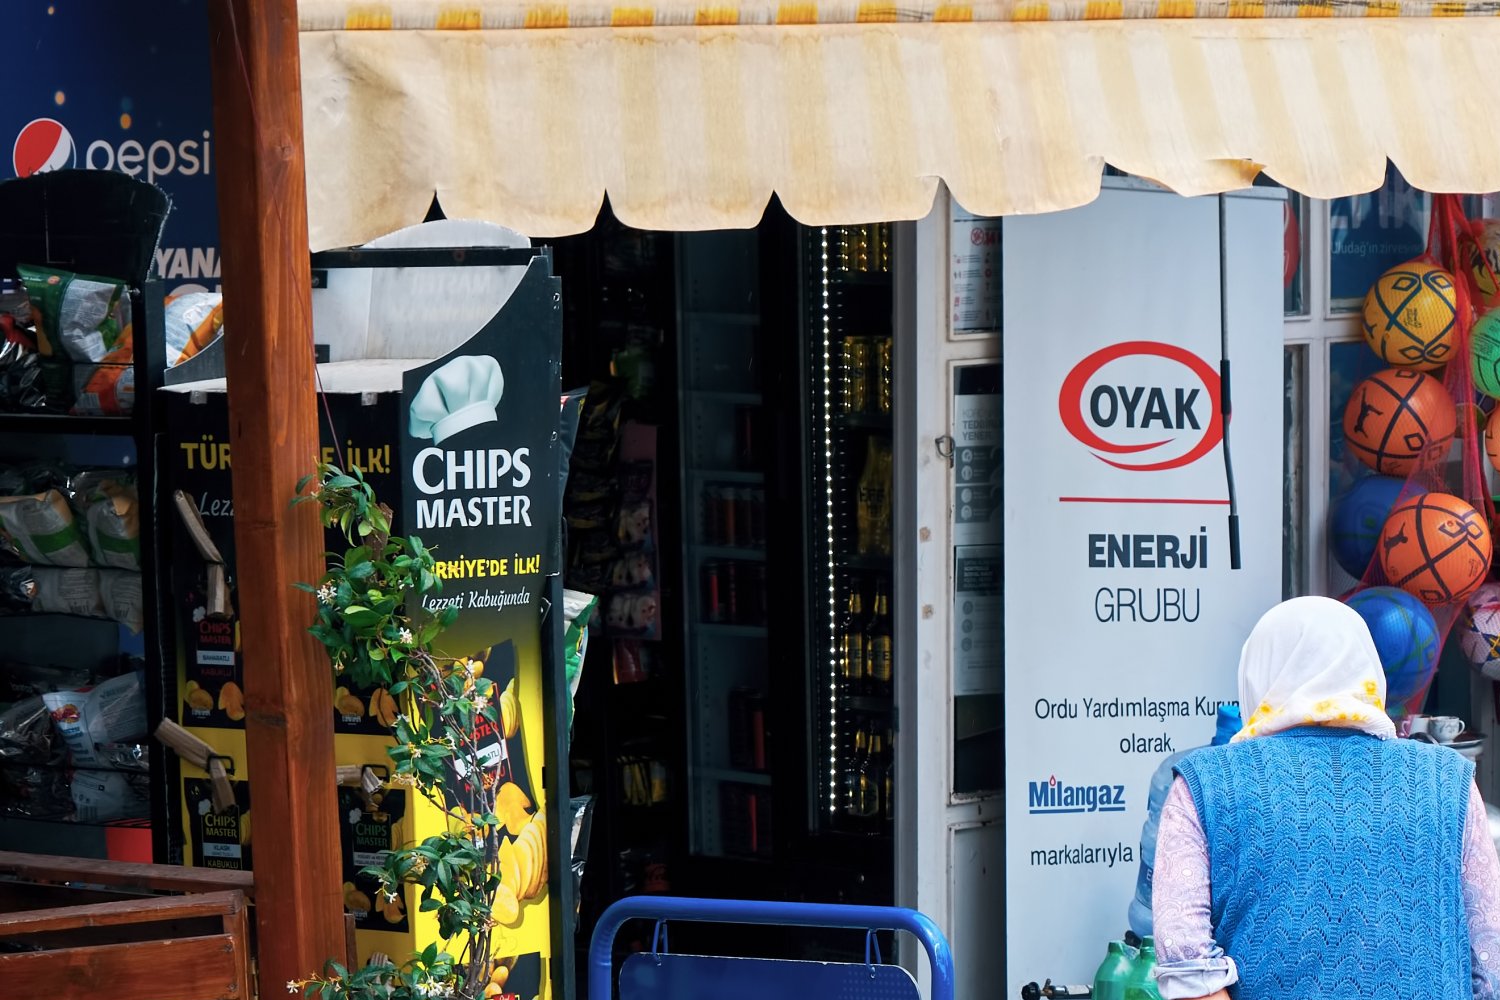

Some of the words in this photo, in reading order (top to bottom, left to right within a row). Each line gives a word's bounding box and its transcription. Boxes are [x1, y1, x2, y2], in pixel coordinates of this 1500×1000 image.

[1090, 384, 1201, 430] OYAK
[412, 447, 531, 495] CHIPS
[416, 495, 532, 529] MASTER
[1088, 526, 1207, 569] ENERJİ
[514, 553, 541, 575] İLK!
[467, 586, 531, 613] Kabuğunda
[1095, 587, 1200, 623] GRUBU
[1035, 698, 1078, 719] Ordu
[1083, 697, 1190, 722] Yardımlaşma
[1120, 733, 1175, 755] olarak,
[1029, 775, 1125, 813] Milangaz
[204, 813, 236, 827] CHIPS
[206, 827, 237, 838] MASTER
[356, 822, 387, 837] CHIPS
[208, 860, 239, 869] KABUKLU
[1031, 842, 1133, 868] markalarıyla
